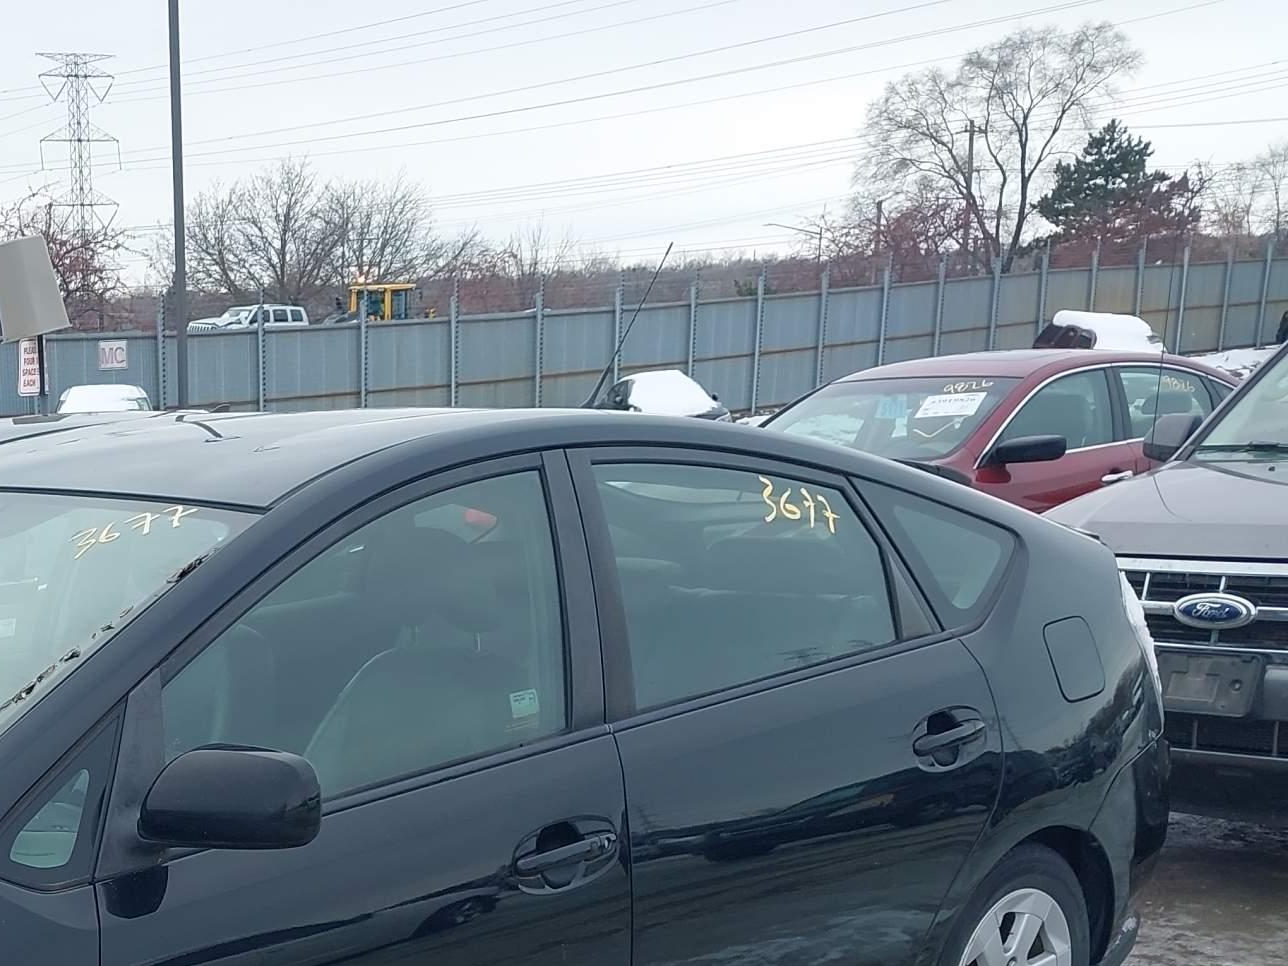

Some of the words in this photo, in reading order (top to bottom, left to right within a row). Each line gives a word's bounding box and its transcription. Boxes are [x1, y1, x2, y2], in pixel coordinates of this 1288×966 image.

[101, 347, 126, 364] MC
[758, 475, 840, 533] 3677
[67, 505, 198, 559] 3677
[1192, 602, 1231, 618] Ford
